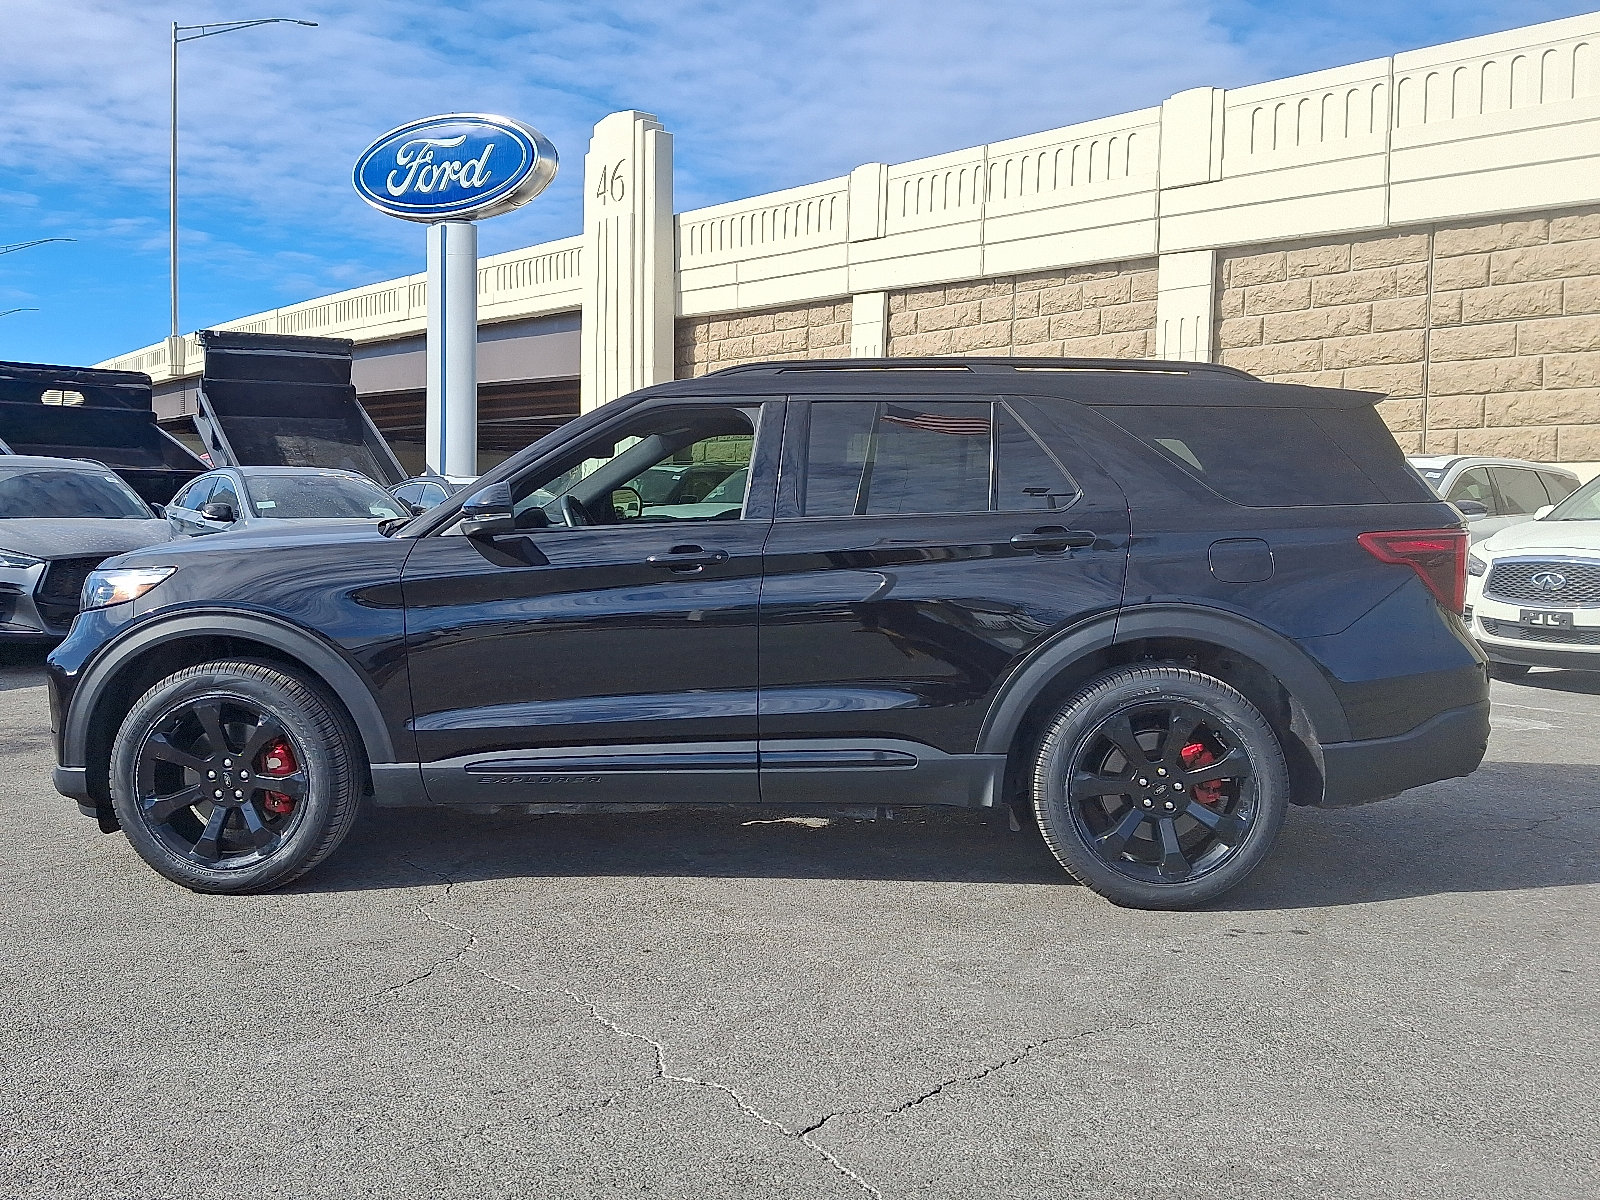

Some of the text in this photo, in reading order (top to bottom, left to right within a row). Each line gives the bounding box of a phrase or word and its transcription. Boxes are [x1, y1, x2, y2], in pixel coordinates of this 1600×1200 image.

[386, 134, 495, 196] Ford
[597, 158, 626, 206] 46
[478, 776, 602, 784] EXPLORER
